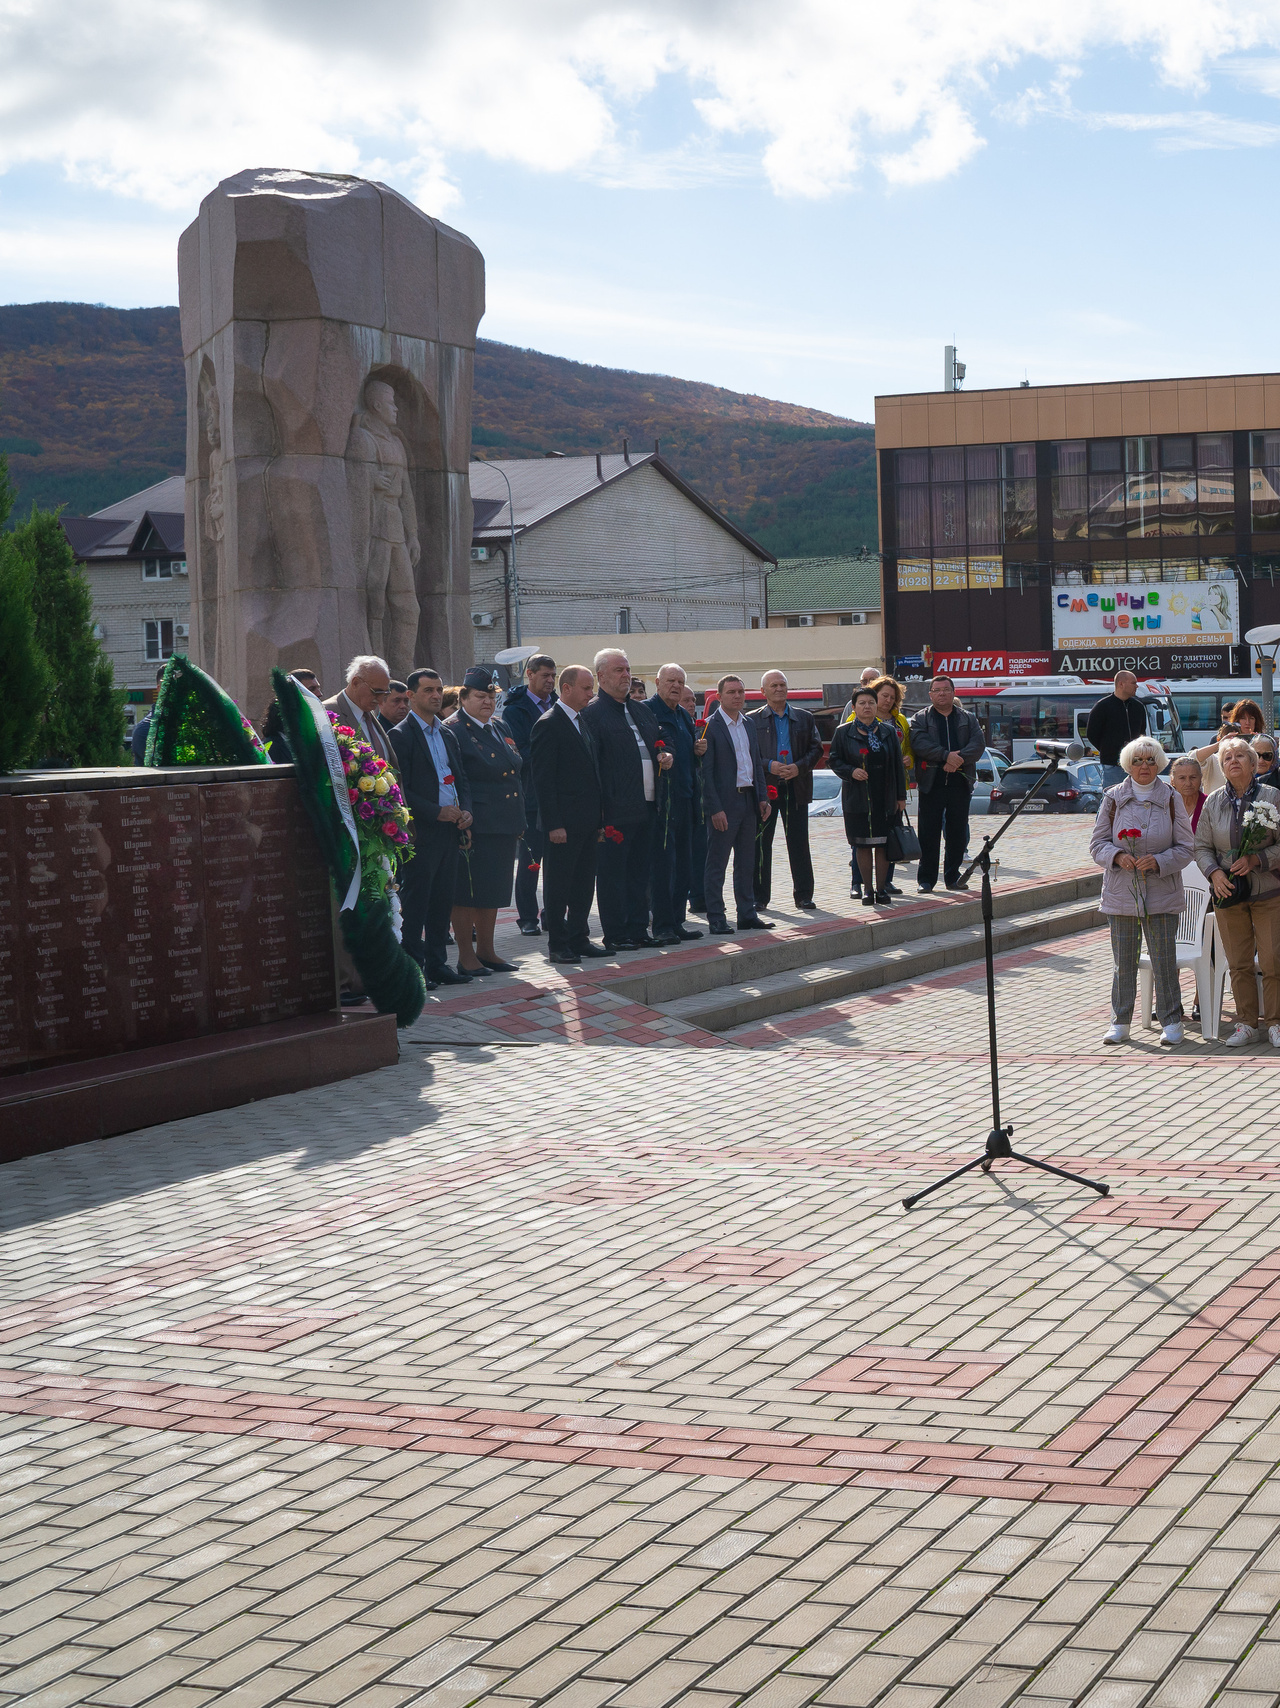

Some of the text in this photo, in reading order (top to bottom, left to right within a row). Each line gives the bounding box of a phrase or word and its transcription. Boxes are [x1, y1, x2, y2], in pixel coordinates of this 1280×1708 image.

[898, 574, 998, 588] 8(928) 22-11 999
[1062, 634, 1225, 648] ОДЕЖДА И ОБУВЬ ДЛЯ ВСЕЙ СЕМЬИ
[936, 656, 1004, 673] АПТЕКА
[1058, 654, 1161, 673] Алкотека
[1170, 654, 1181, 662] От
[1182, 653, 1221, 662] элитного
[1170, 661, 1217, 670] до простого
